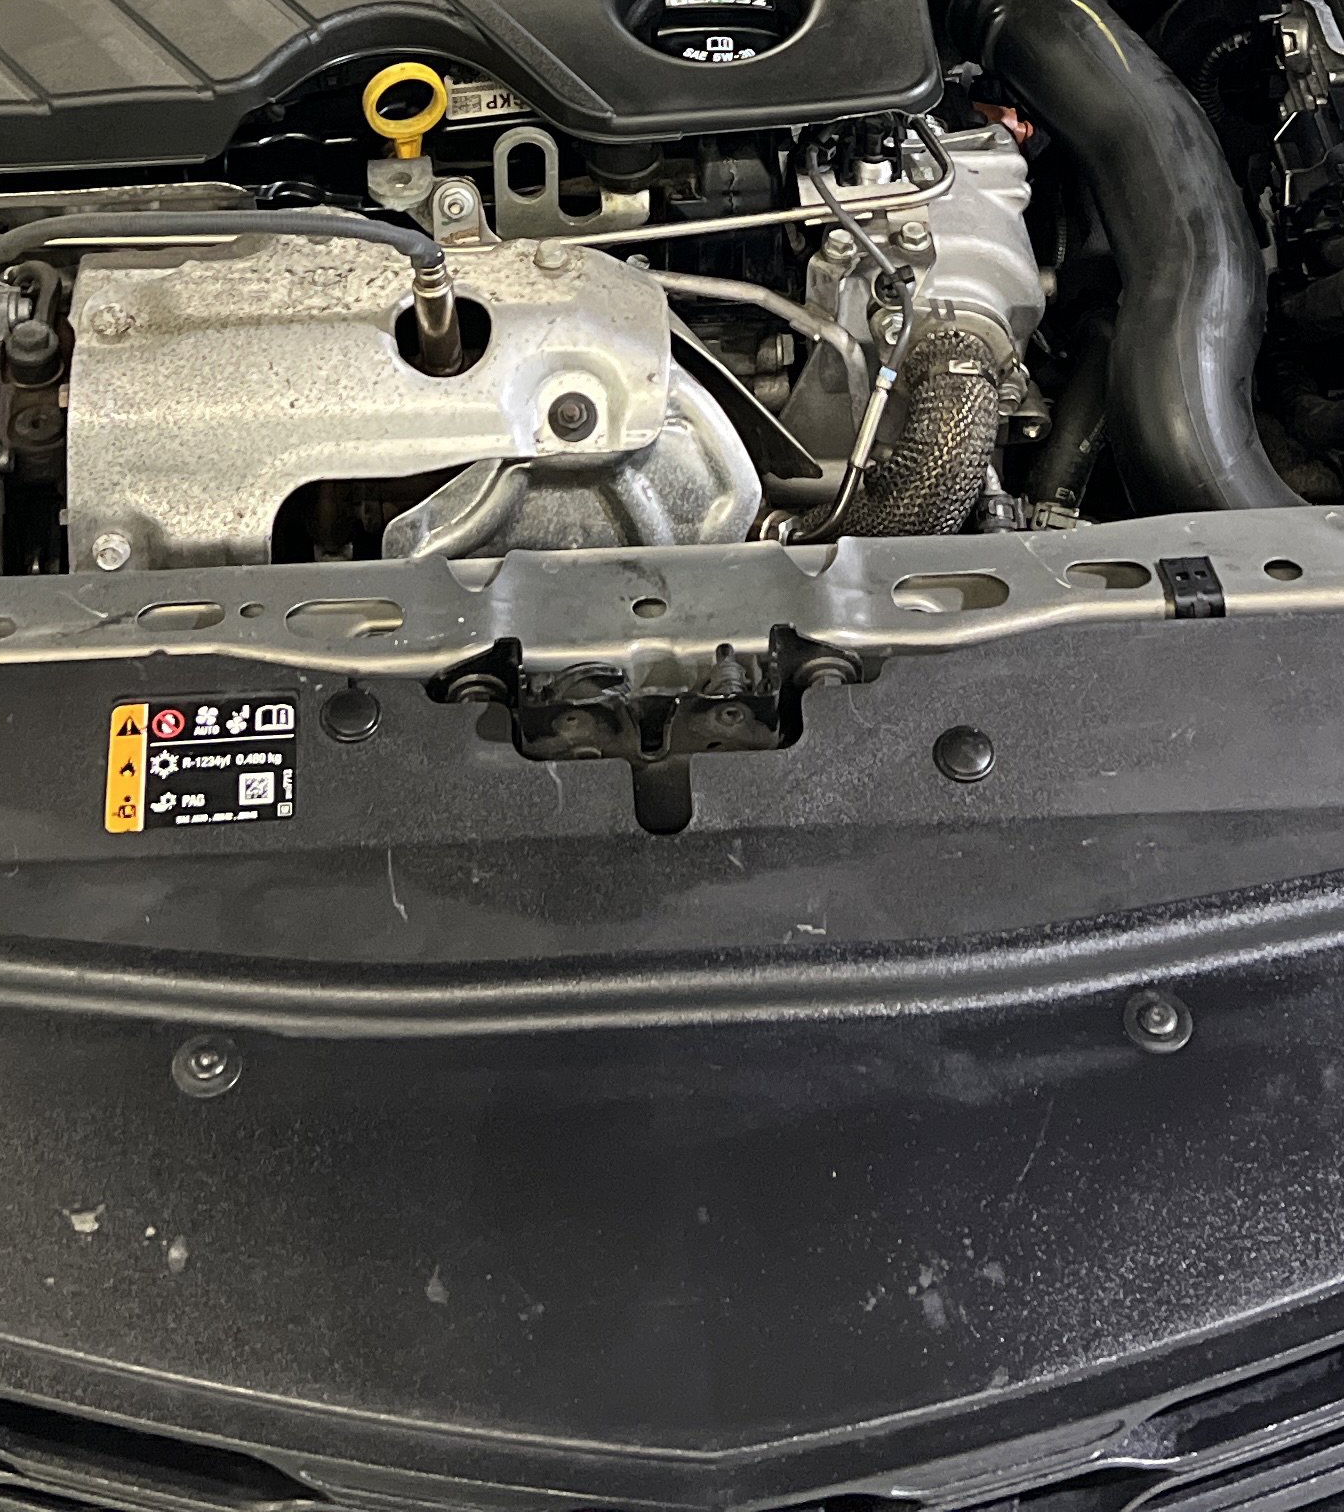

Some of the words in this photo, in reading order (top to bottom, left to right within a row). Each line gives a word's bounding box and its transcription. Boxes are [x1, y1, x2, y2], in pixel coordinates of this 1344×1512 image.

[682, 47, 709, 61] SAE
[712, 48, 756, 63] 5W-30
[193, 724, 221, 736] AUTO
[182, 753, 232, 769] R-1234yf
[267, 751, 283, 766] kg
[181, 793, 206, 808] PAG
